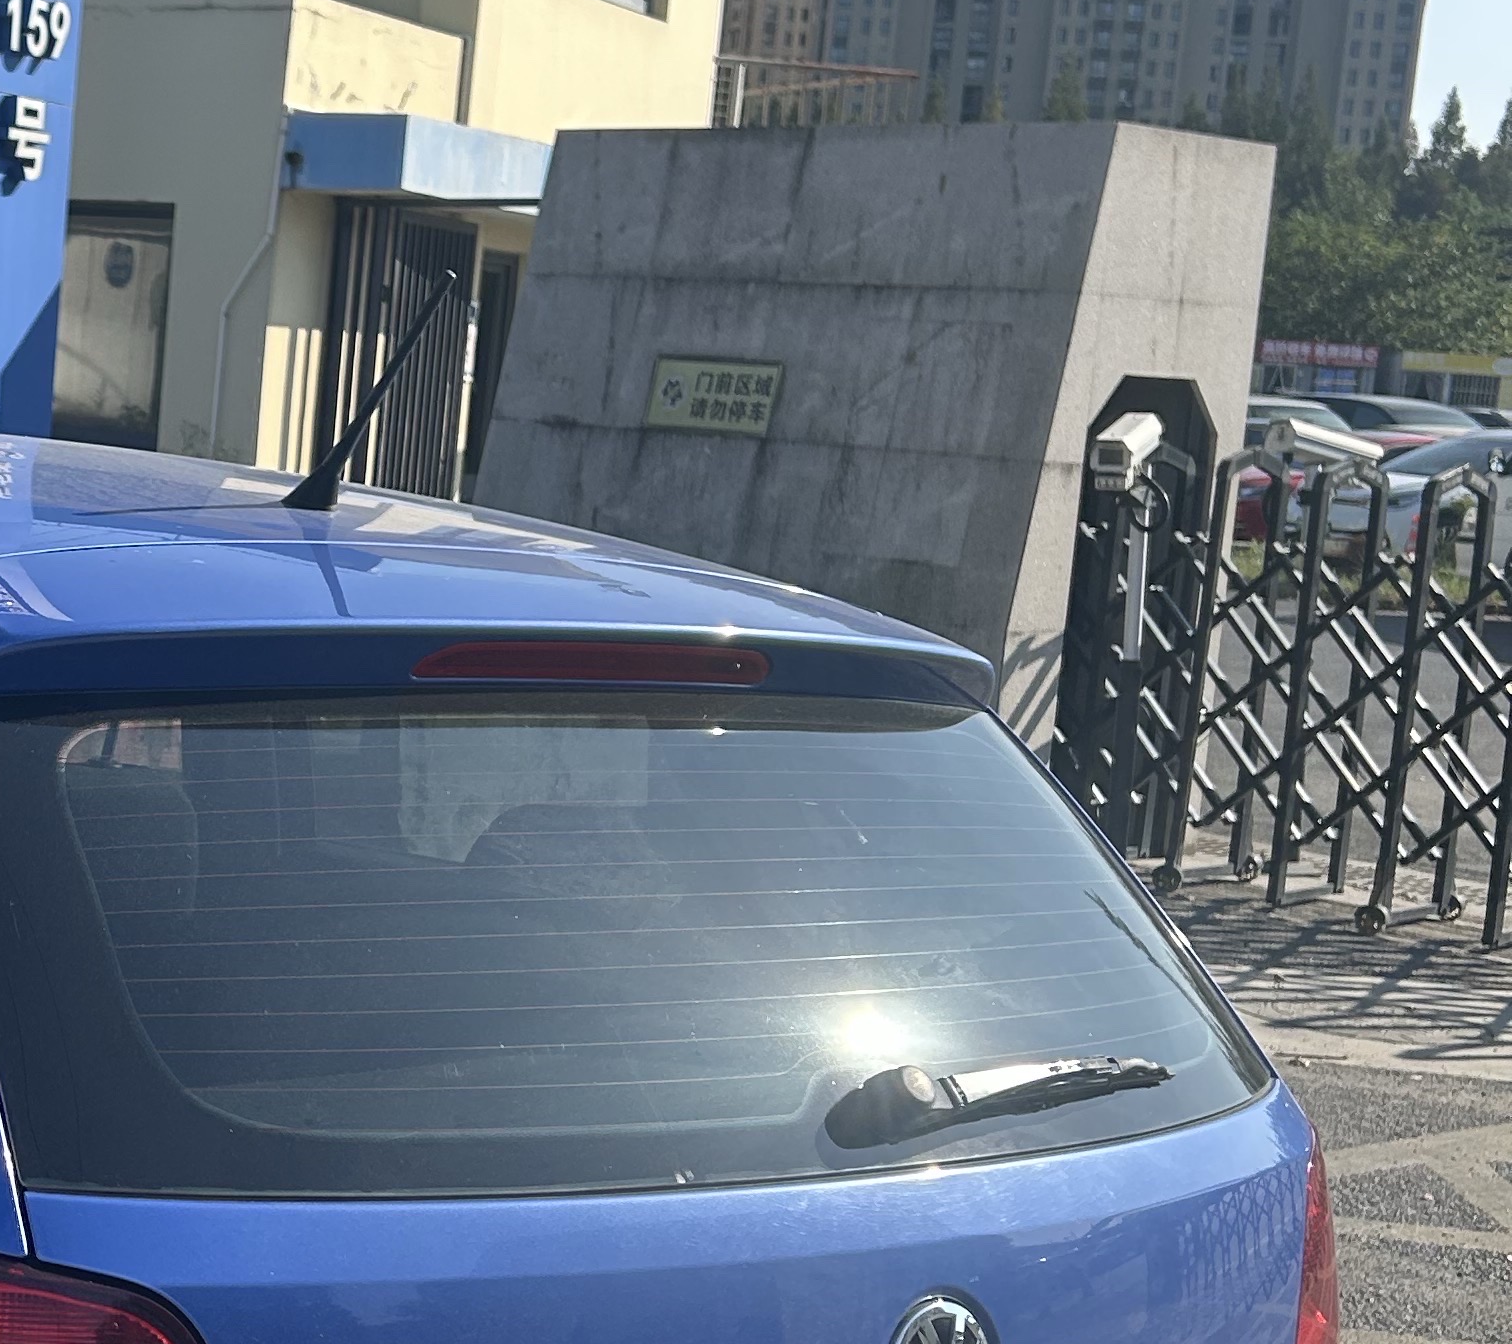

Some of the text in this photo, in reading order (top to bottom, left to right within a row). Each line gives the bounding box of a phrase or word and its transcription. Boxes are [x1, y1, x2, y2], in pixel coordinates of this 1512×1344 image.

[695, 370, 774, 397] 门前区域
[690, 398, 767, 424] 请勿停车
